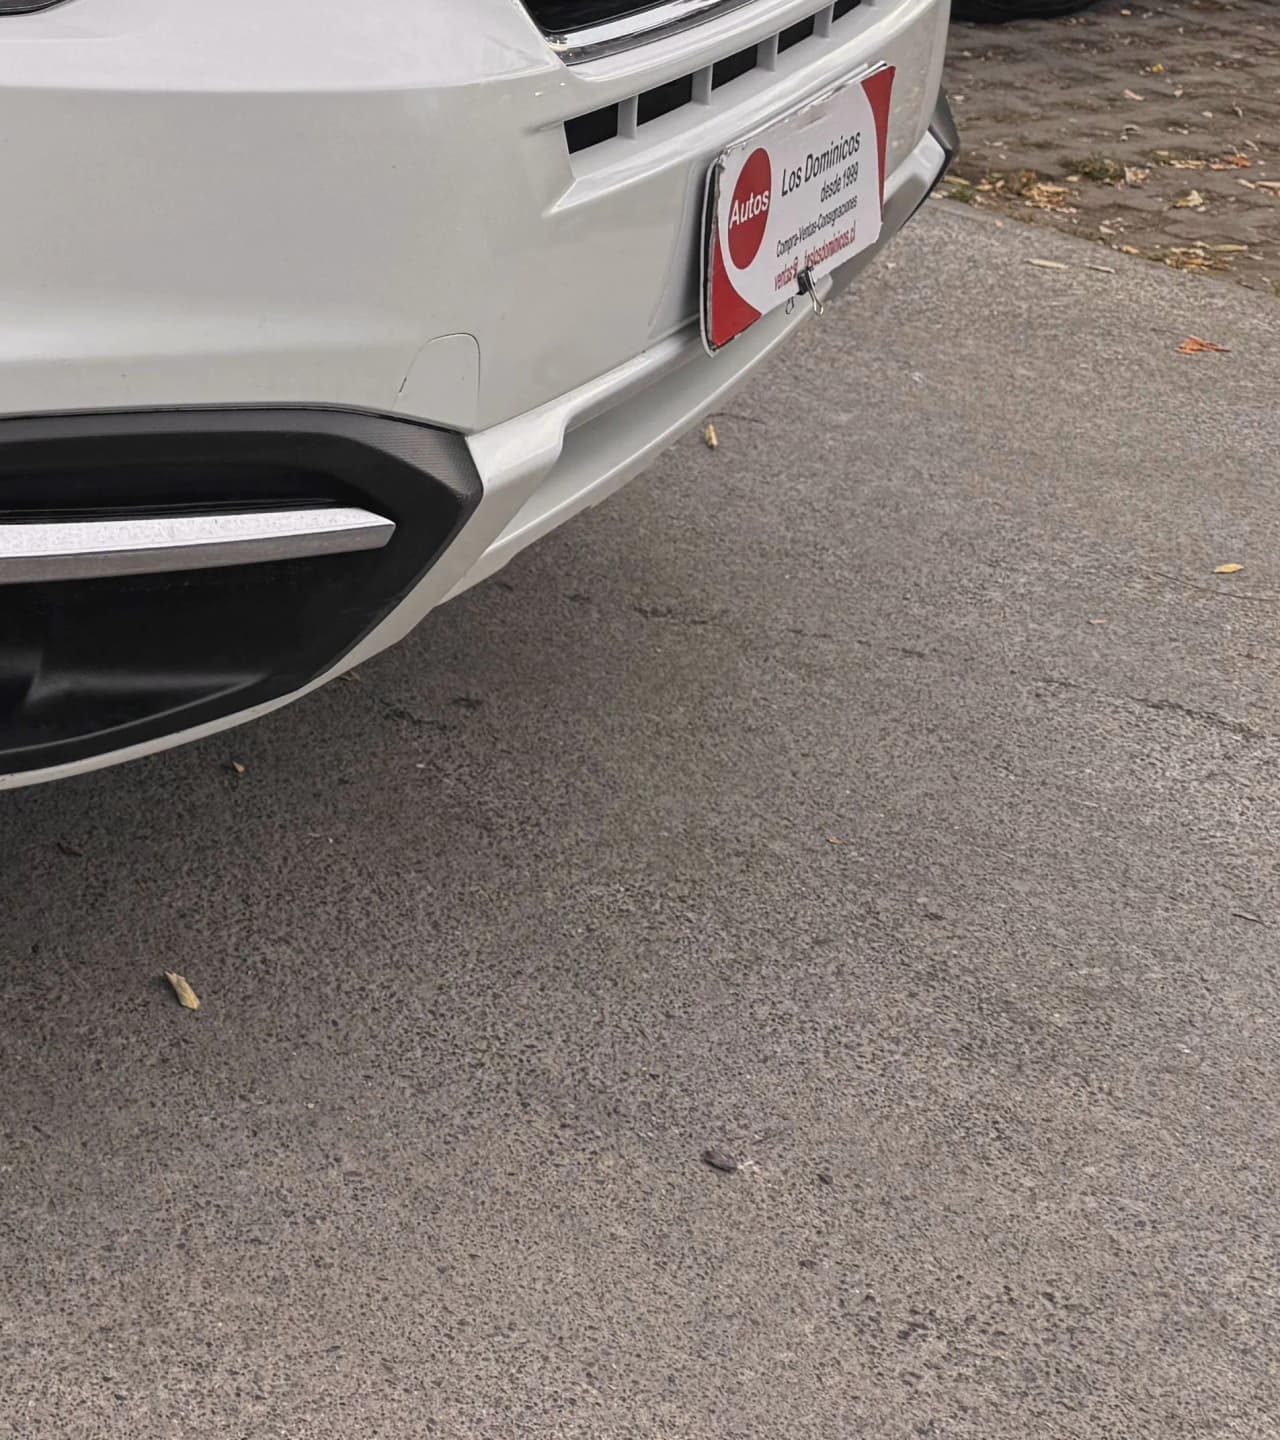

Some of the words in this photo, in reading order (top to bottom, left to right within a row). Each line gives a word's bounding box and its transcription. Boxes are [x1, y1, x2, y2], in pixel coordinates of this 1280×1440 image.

[781, 166, 802, 197] Los
[804, 132, 861, 183] Dominicos
[820, 172, 842, 202] desde
[842, 161, 859, 189] 1999
[729, 190, 770, 229] Autos
